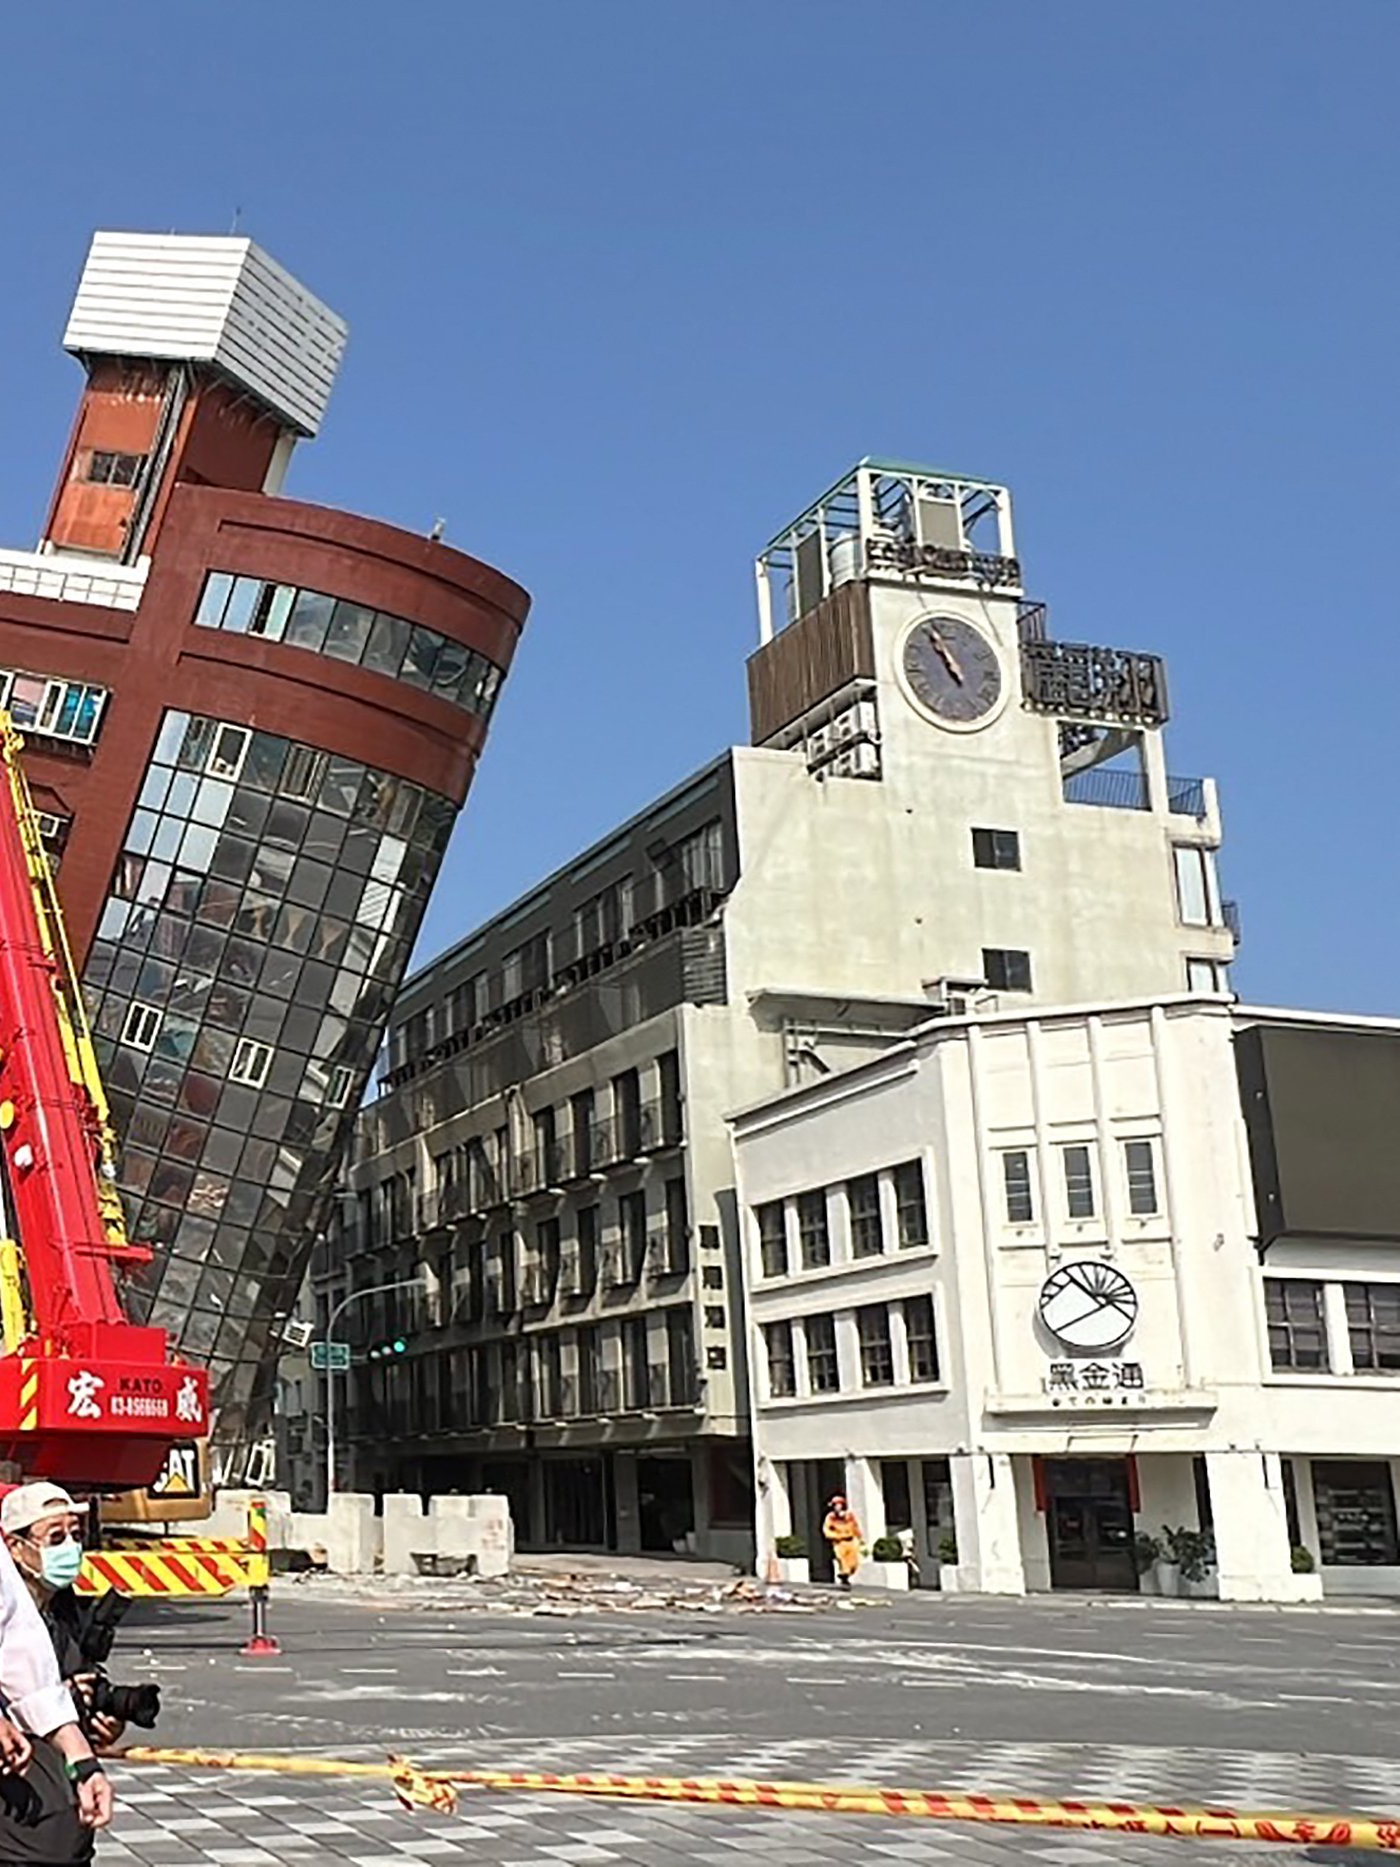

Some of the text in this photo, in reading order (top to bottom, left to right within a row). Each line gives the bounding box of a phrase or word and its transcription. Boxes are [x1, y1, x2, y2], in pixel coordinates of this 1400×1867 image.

[119, 1377, 163, 1394] KATO
[1049, 1361, 1144, 1391] 黑金通
